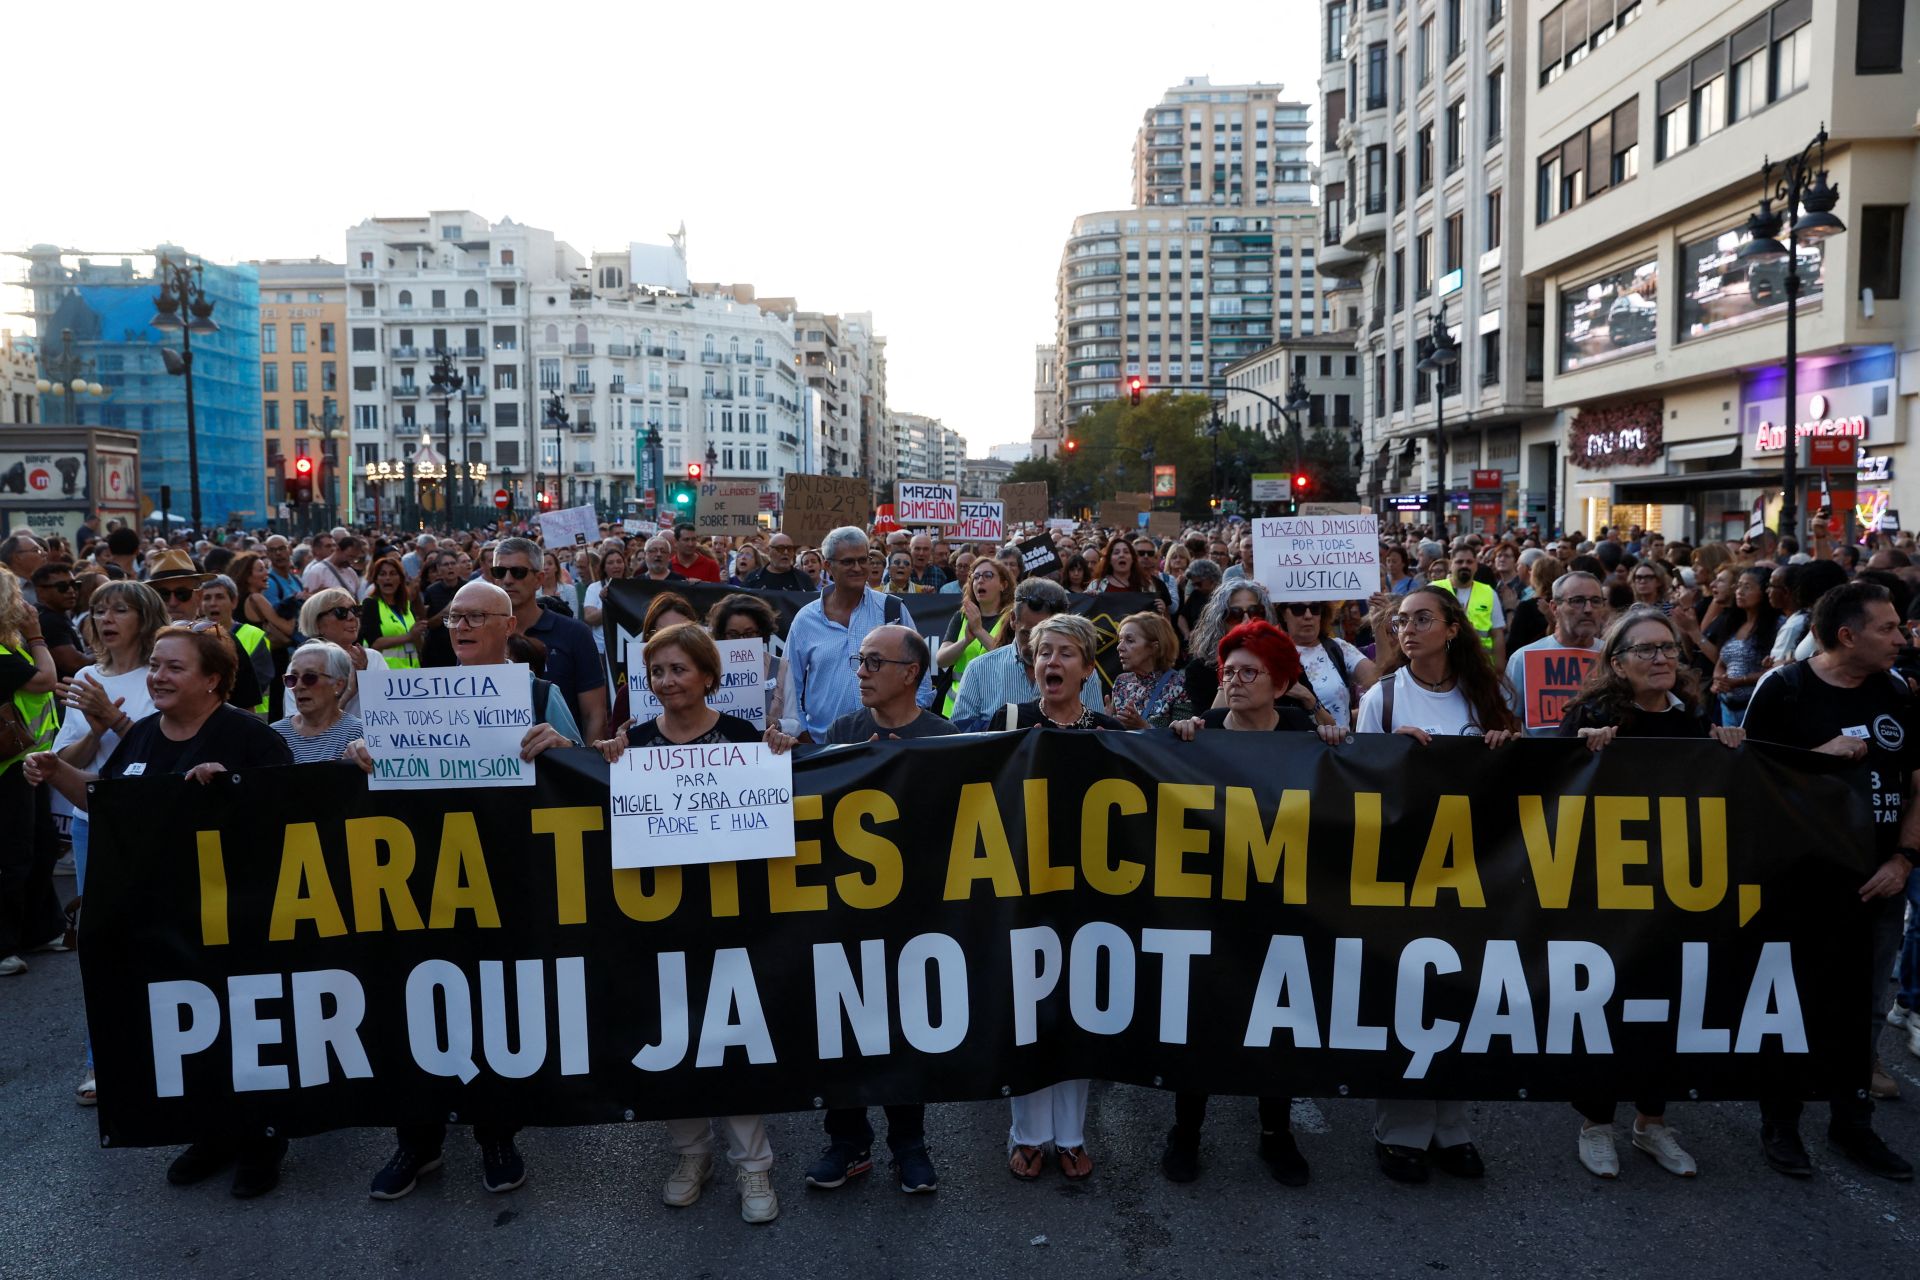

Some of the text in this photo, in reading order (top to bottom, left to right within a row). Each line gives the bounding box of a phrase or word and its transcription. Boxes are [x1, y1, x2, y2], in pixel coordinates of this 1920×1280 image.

[701, 484, 717, 496] PP
[902, 484, 953, 500] MAZÓN
[714, 502, 725, 511] DE
[830, 495, 856, 512] 29
[960, 502, 1000, 518] AZÓN
[699, 514, 728, 527] SOBRE
[1261, 516, 1377, 537] MAZÓN DIMISIÓN
[1292, 538, 1355, 551] POR TODAS
[1022, 545, 1048, 562] AZÓN
[1278, 551, 1375, 566] LAS VÍCTIMAS
[1285, 571, 1361, 588] JUSTICIA
[730, 650, 755, 662] PARA
[384, 676, 499, 697] JUSTICIA
[364, 706, 531, 726] PARA TODAS LAS VÍCTIMAS
[368, 730, 471, 748] DE VALÈNCIA
[371, 754, 521, 779] MAZÓN DIMISIÓN
[676, 772, 718, 787] PARA
[612, 787, 790, 814] MIGUEL Y SARA CARPIO
[648, 812, 769, 834] PADRE E HIJA
[196, 830, 229, 946] I
[268, 811, 502, 942] ARA
[943, 778, 1310, 905] ALCEM
[1350, 791, 1487, 908] LA
[1517, 795, 1761, 928] VEU,
[147, 921, 1810, 1098] PER QUI JA NO POT ALÇAR-LA
